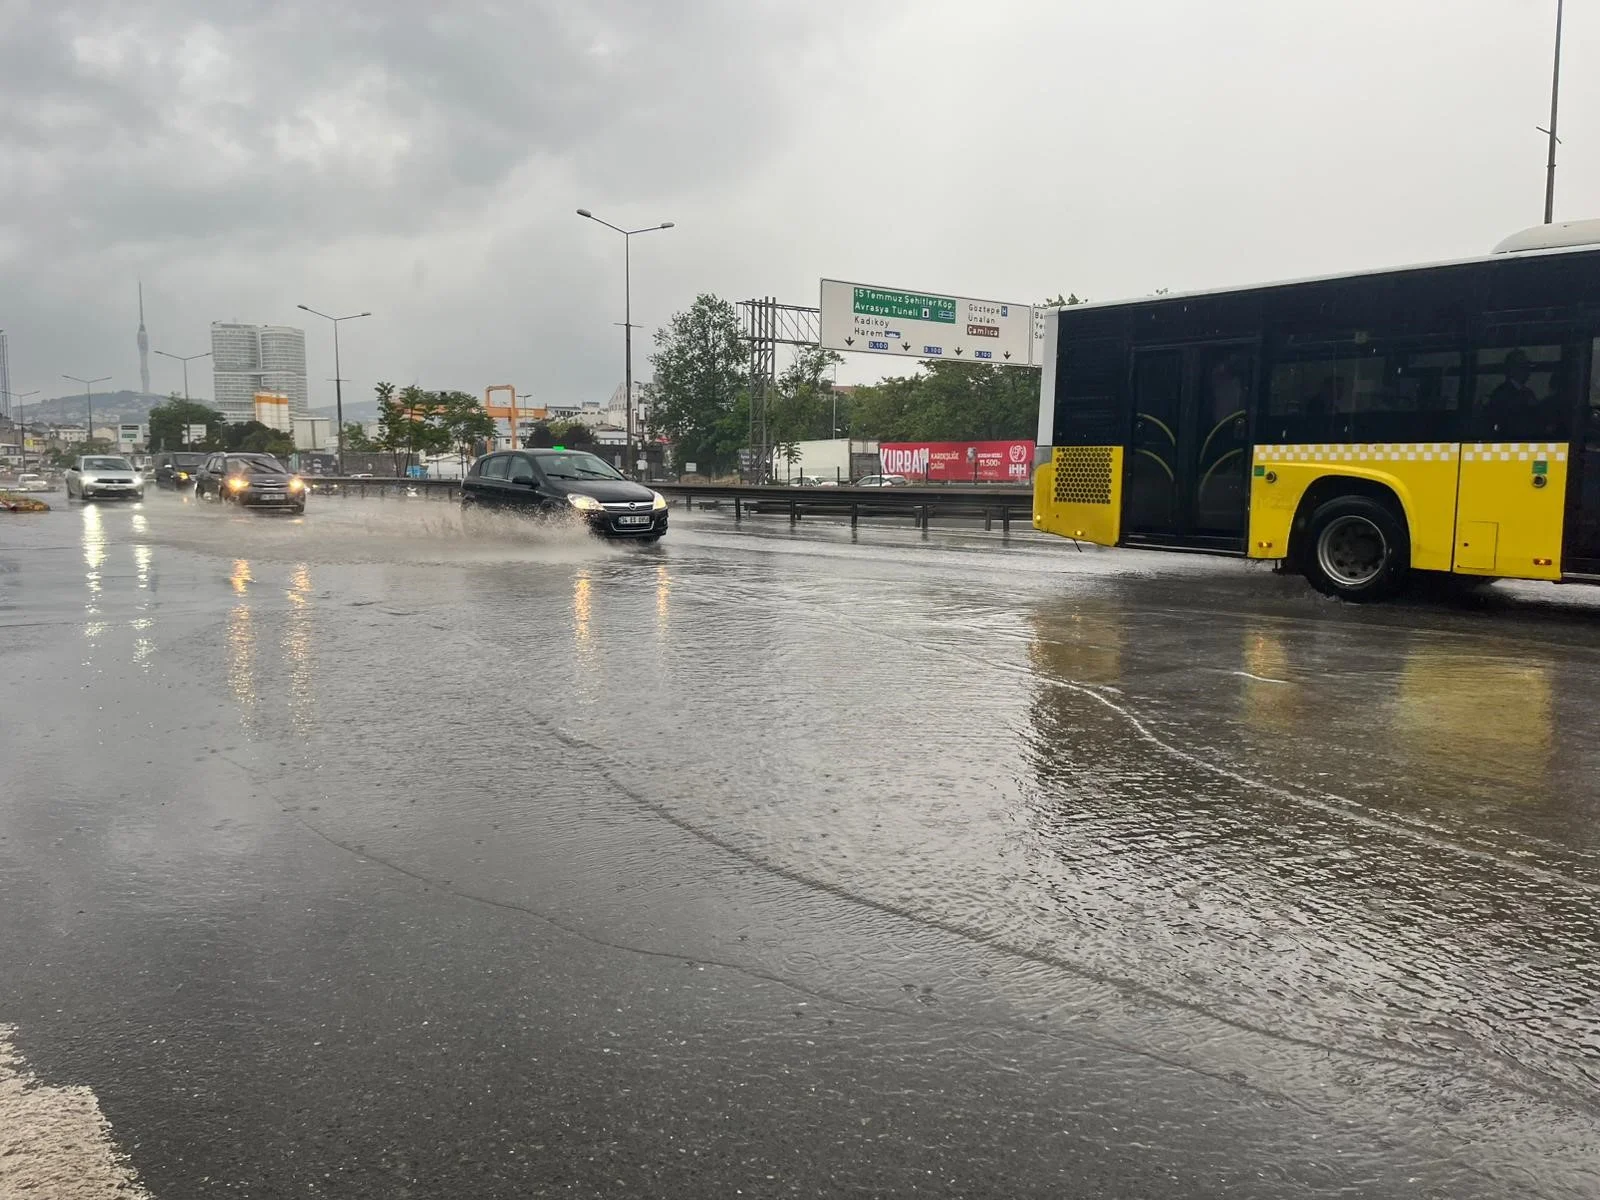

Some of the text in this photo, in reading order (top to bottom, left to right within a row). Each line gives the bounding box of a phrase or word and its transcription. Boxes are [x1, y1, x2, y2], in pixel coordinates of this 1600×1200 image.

[855, 289, 865, 298] 15
[866, 290, 903, 303] Temmuz
[904, 295, 936, 307] Şehitler
[855, 302, 889, 315] Avrasya
[855, 327, 883, 338] Harem
[880, 447, 929, 474] KURBAN
